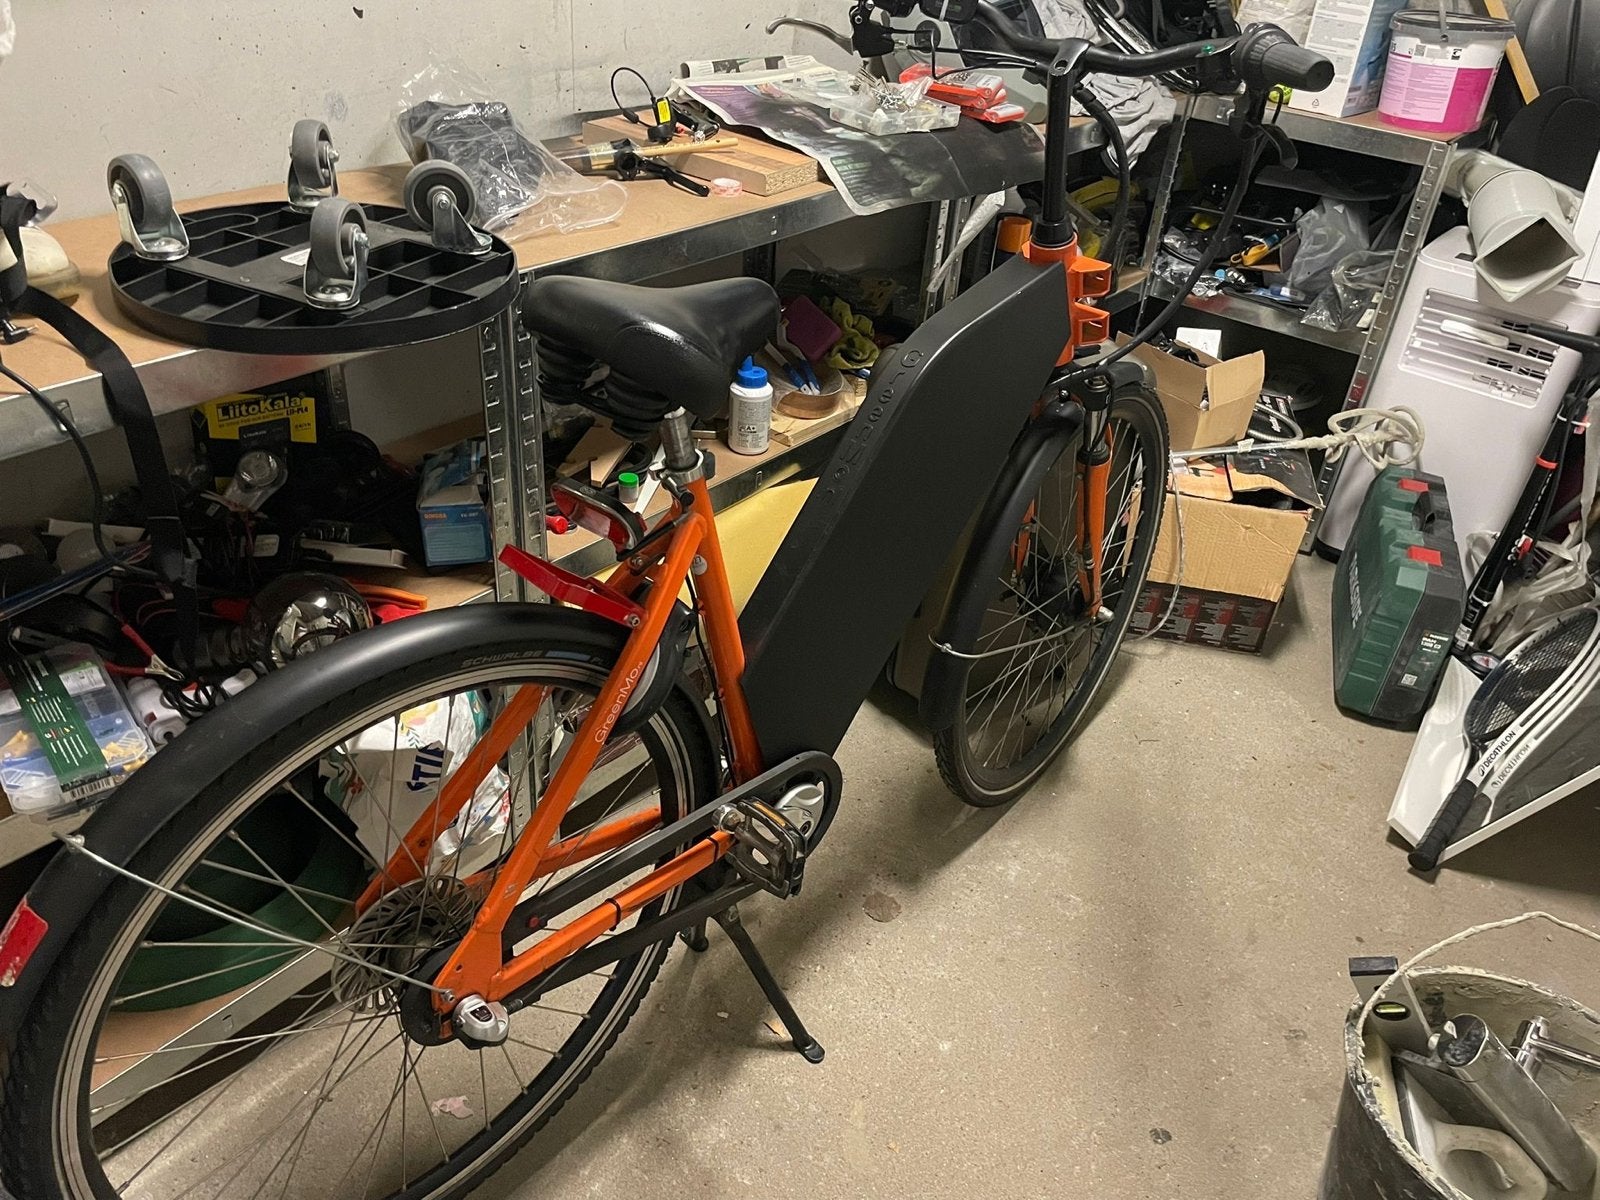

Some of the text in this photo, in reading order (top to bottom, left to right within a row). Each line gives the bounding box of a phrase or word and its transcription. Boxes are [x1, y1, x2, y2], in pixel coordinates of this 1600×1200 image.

[217, 395, 303, 420] LiitoKala
[461, 650, 543, 668] SCHWALBE
[1483, 730, 1517, 768] DECATHLON
